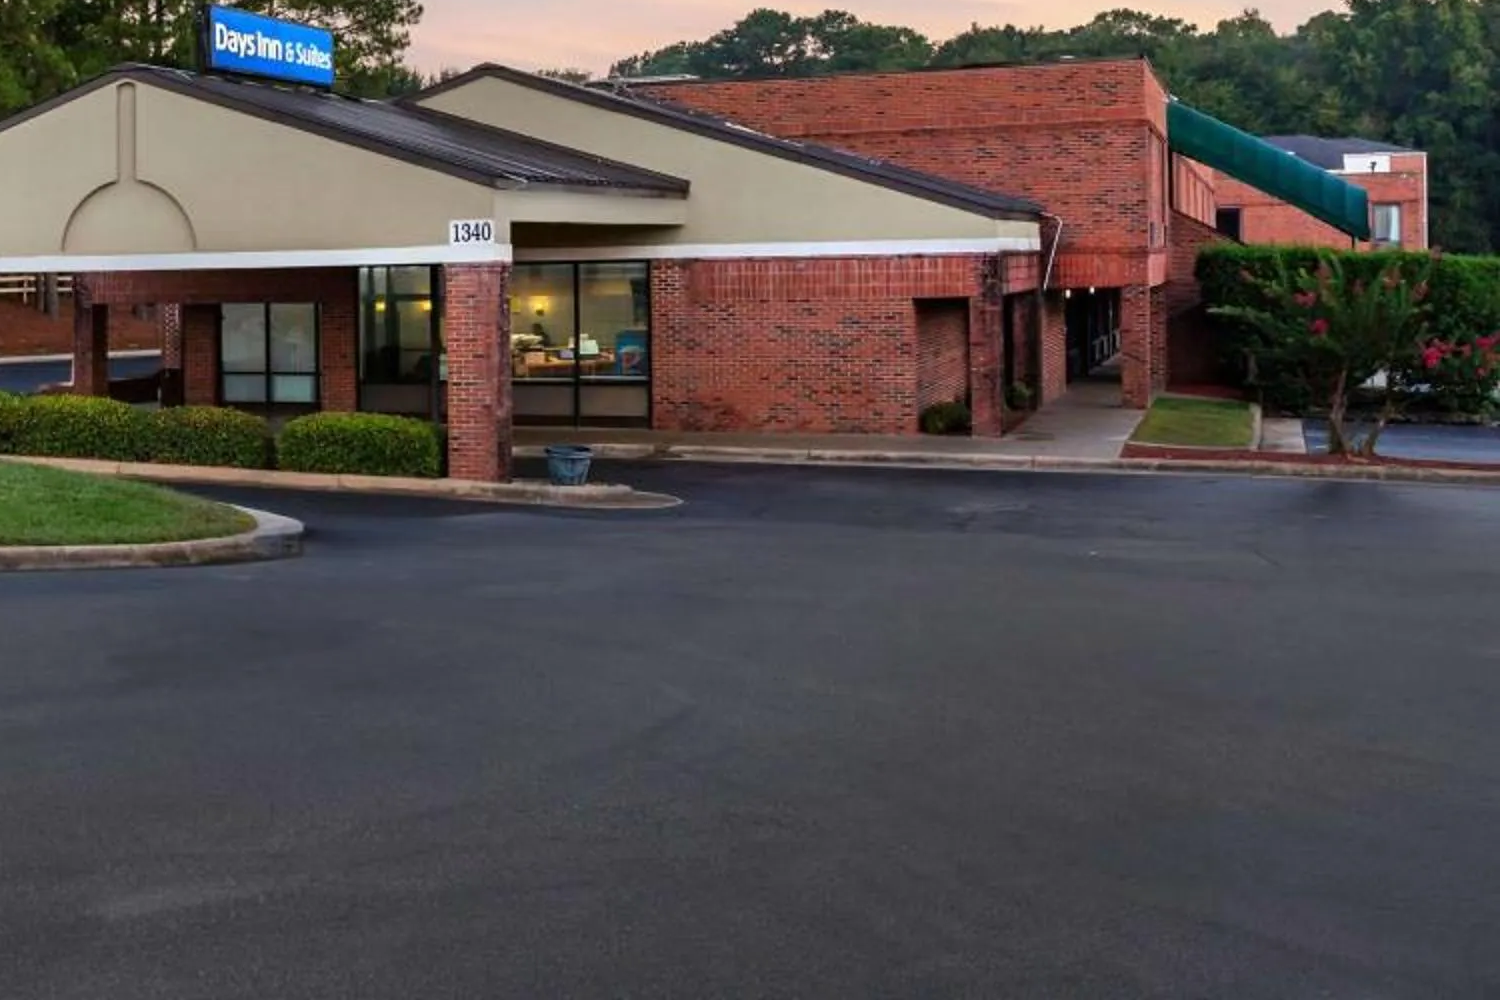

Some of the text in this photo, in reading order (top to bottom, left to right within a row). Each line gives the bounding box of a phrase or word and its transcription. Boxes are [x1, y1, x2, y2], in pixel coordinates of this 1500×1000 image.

[215, 22, 332, 70] Days Inn & Suites
[452, 221, 492, 242] 1340
